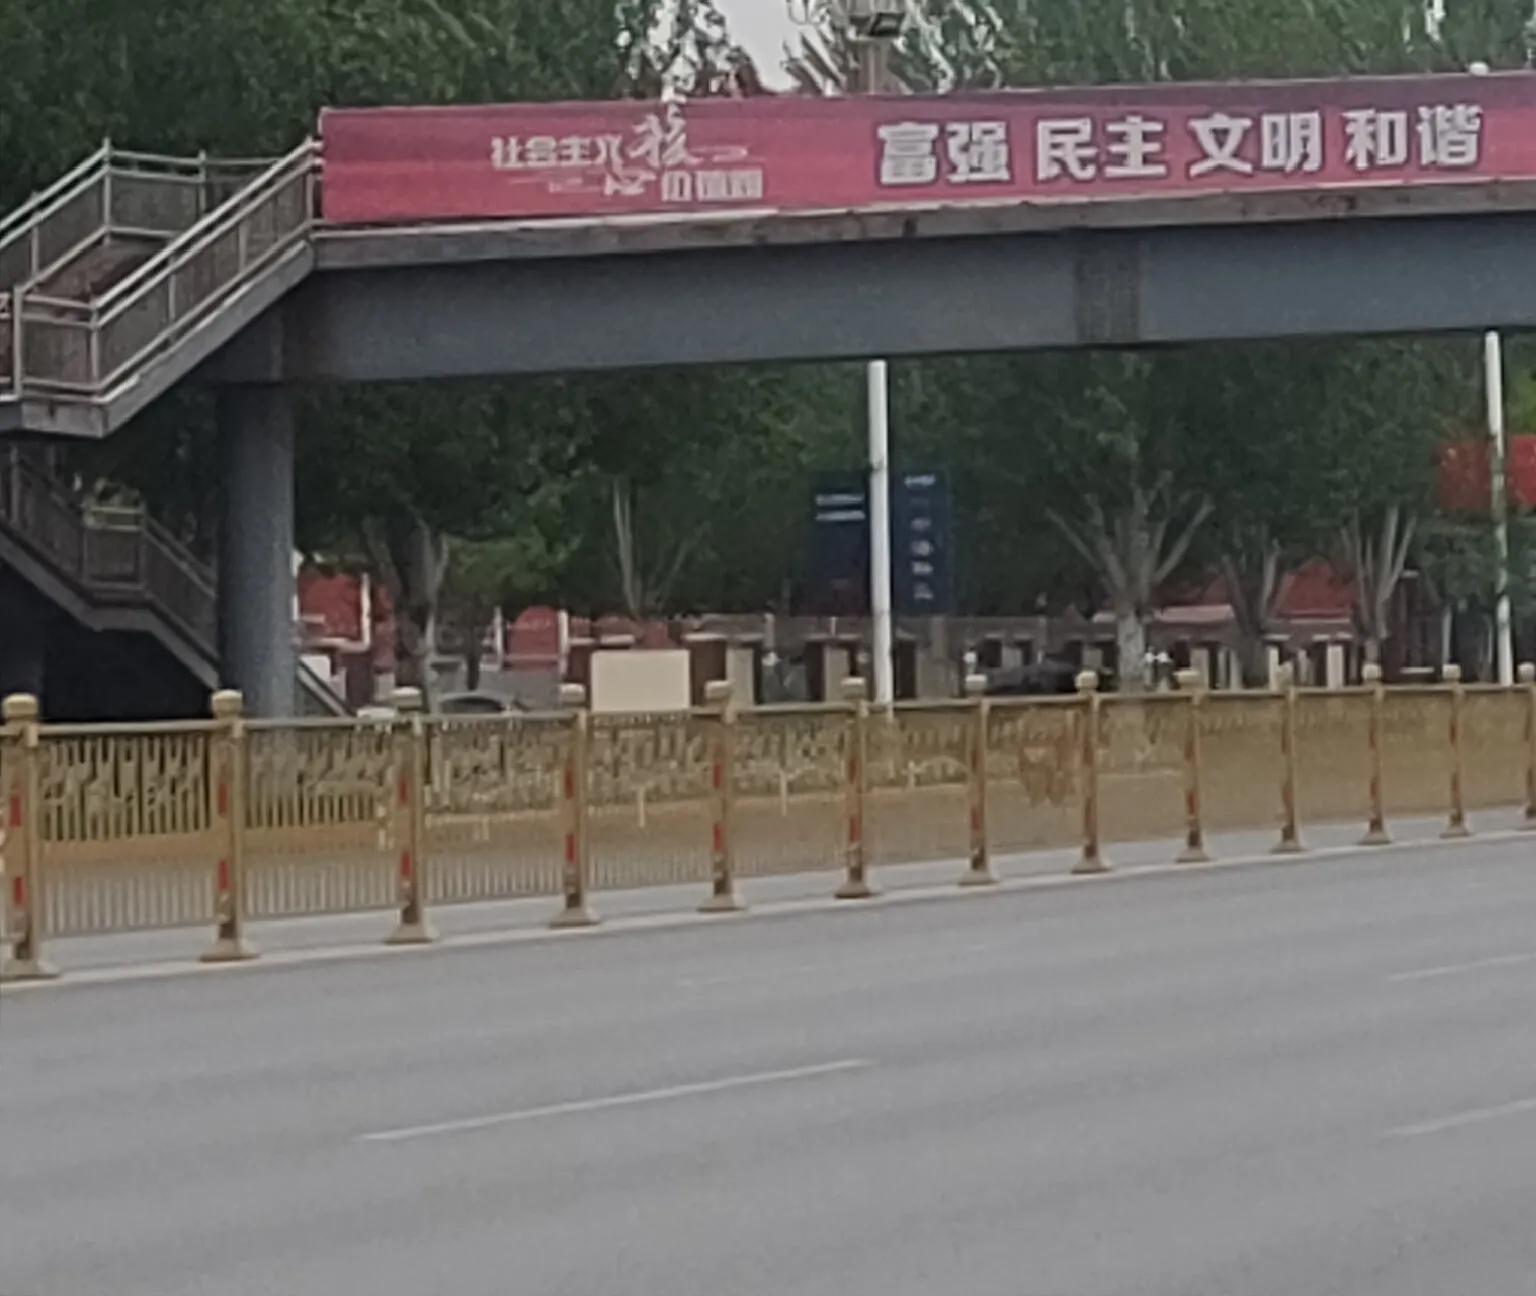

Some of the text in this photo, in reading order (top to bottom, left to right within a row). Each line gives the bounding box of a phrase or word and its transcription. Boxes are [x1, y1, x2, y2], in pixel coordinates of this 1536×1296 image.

[877, 106, 1483, 186] 富强 民主 文明 和谐
